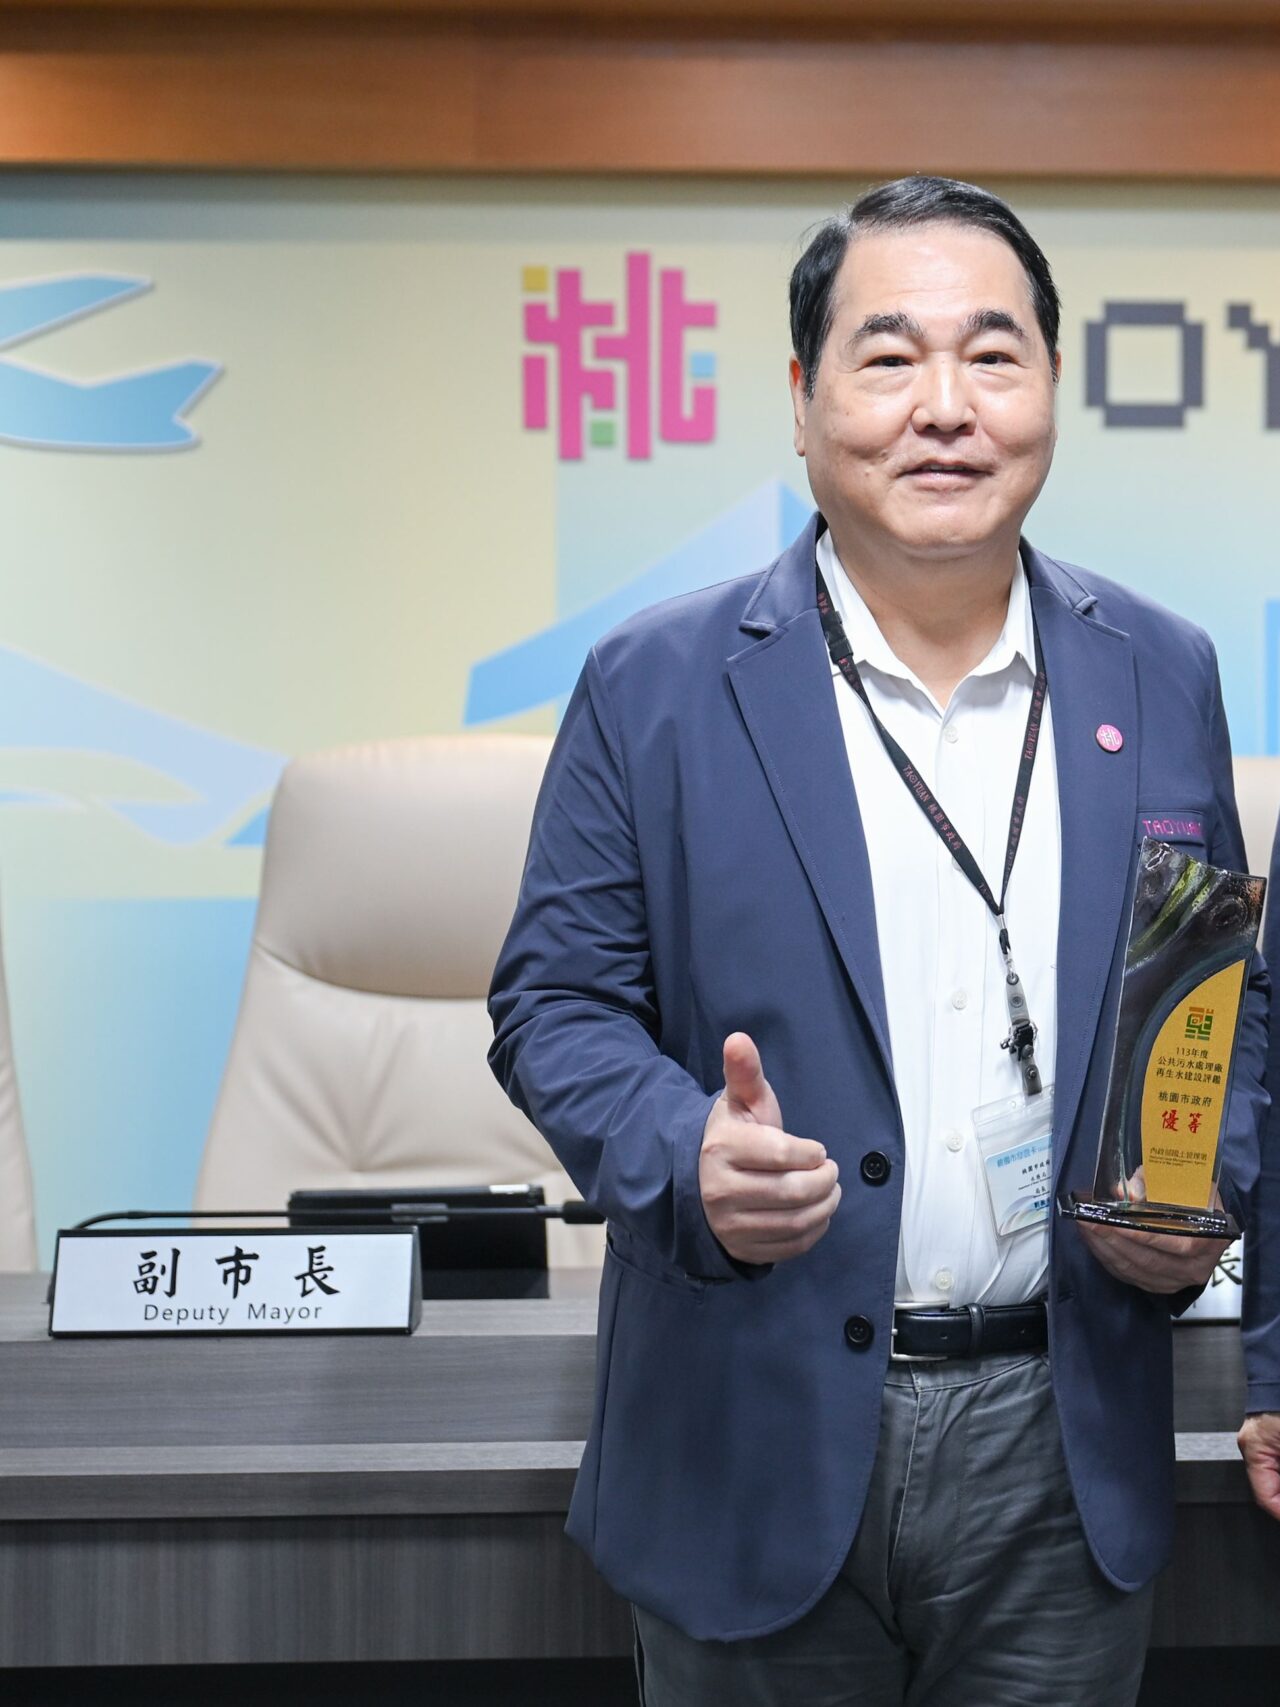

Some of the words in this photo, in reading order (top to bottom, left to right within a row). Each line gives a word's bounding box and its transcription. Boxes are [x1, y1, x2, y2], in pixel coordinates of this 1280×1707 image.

[1176, 1047, 1209, 1060] 113年度
[1158, 1090, 1213, 1107] 桃園市政府
[1161, 1109, 1204, 1134] 優等
[132, 1245, 341, 1300] 副市長
[143, 1303, 230, 1325] Deputy
[247, 1303, 323, 1324] Mayor
